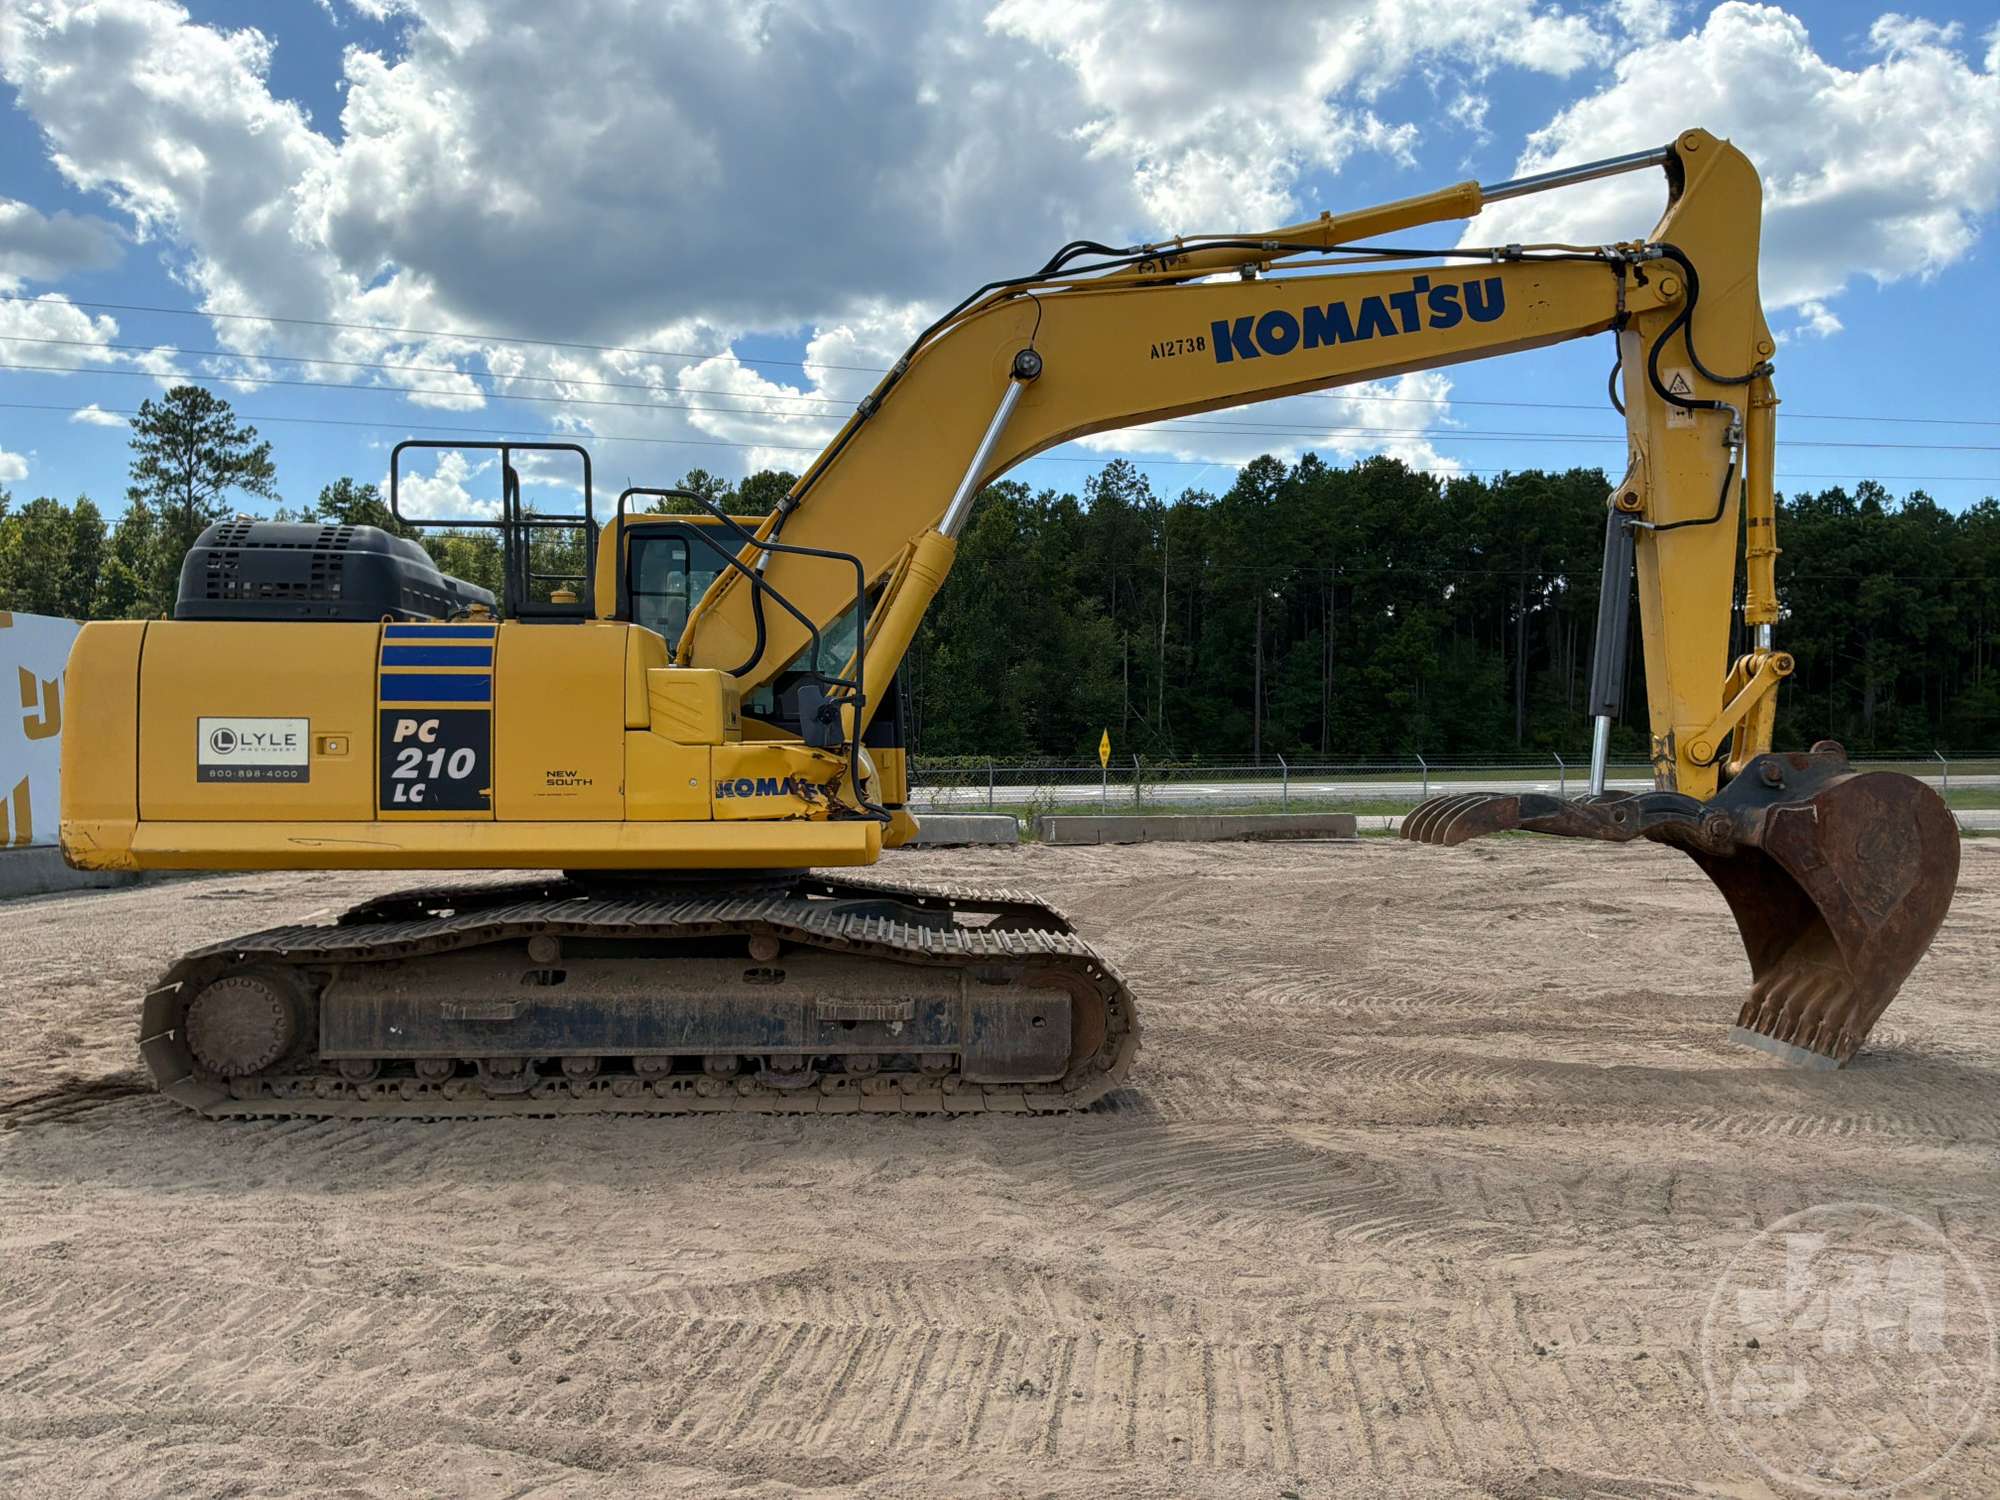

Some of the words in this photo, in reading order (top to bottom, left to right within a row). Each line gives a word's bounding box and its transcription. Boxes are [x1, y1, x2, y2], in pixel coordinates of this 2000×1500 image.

[1210, 275, 1505, 364] KOMATSU
[241, 733, 297, 746] LYLE
[393, 719, 440, 743] PC
[391, 747, 476, 779] 210
[546, 770, 577, 778] NEW
[546, 778, 593, 786] SOUTH
[393, 783, 426, 803] LC
